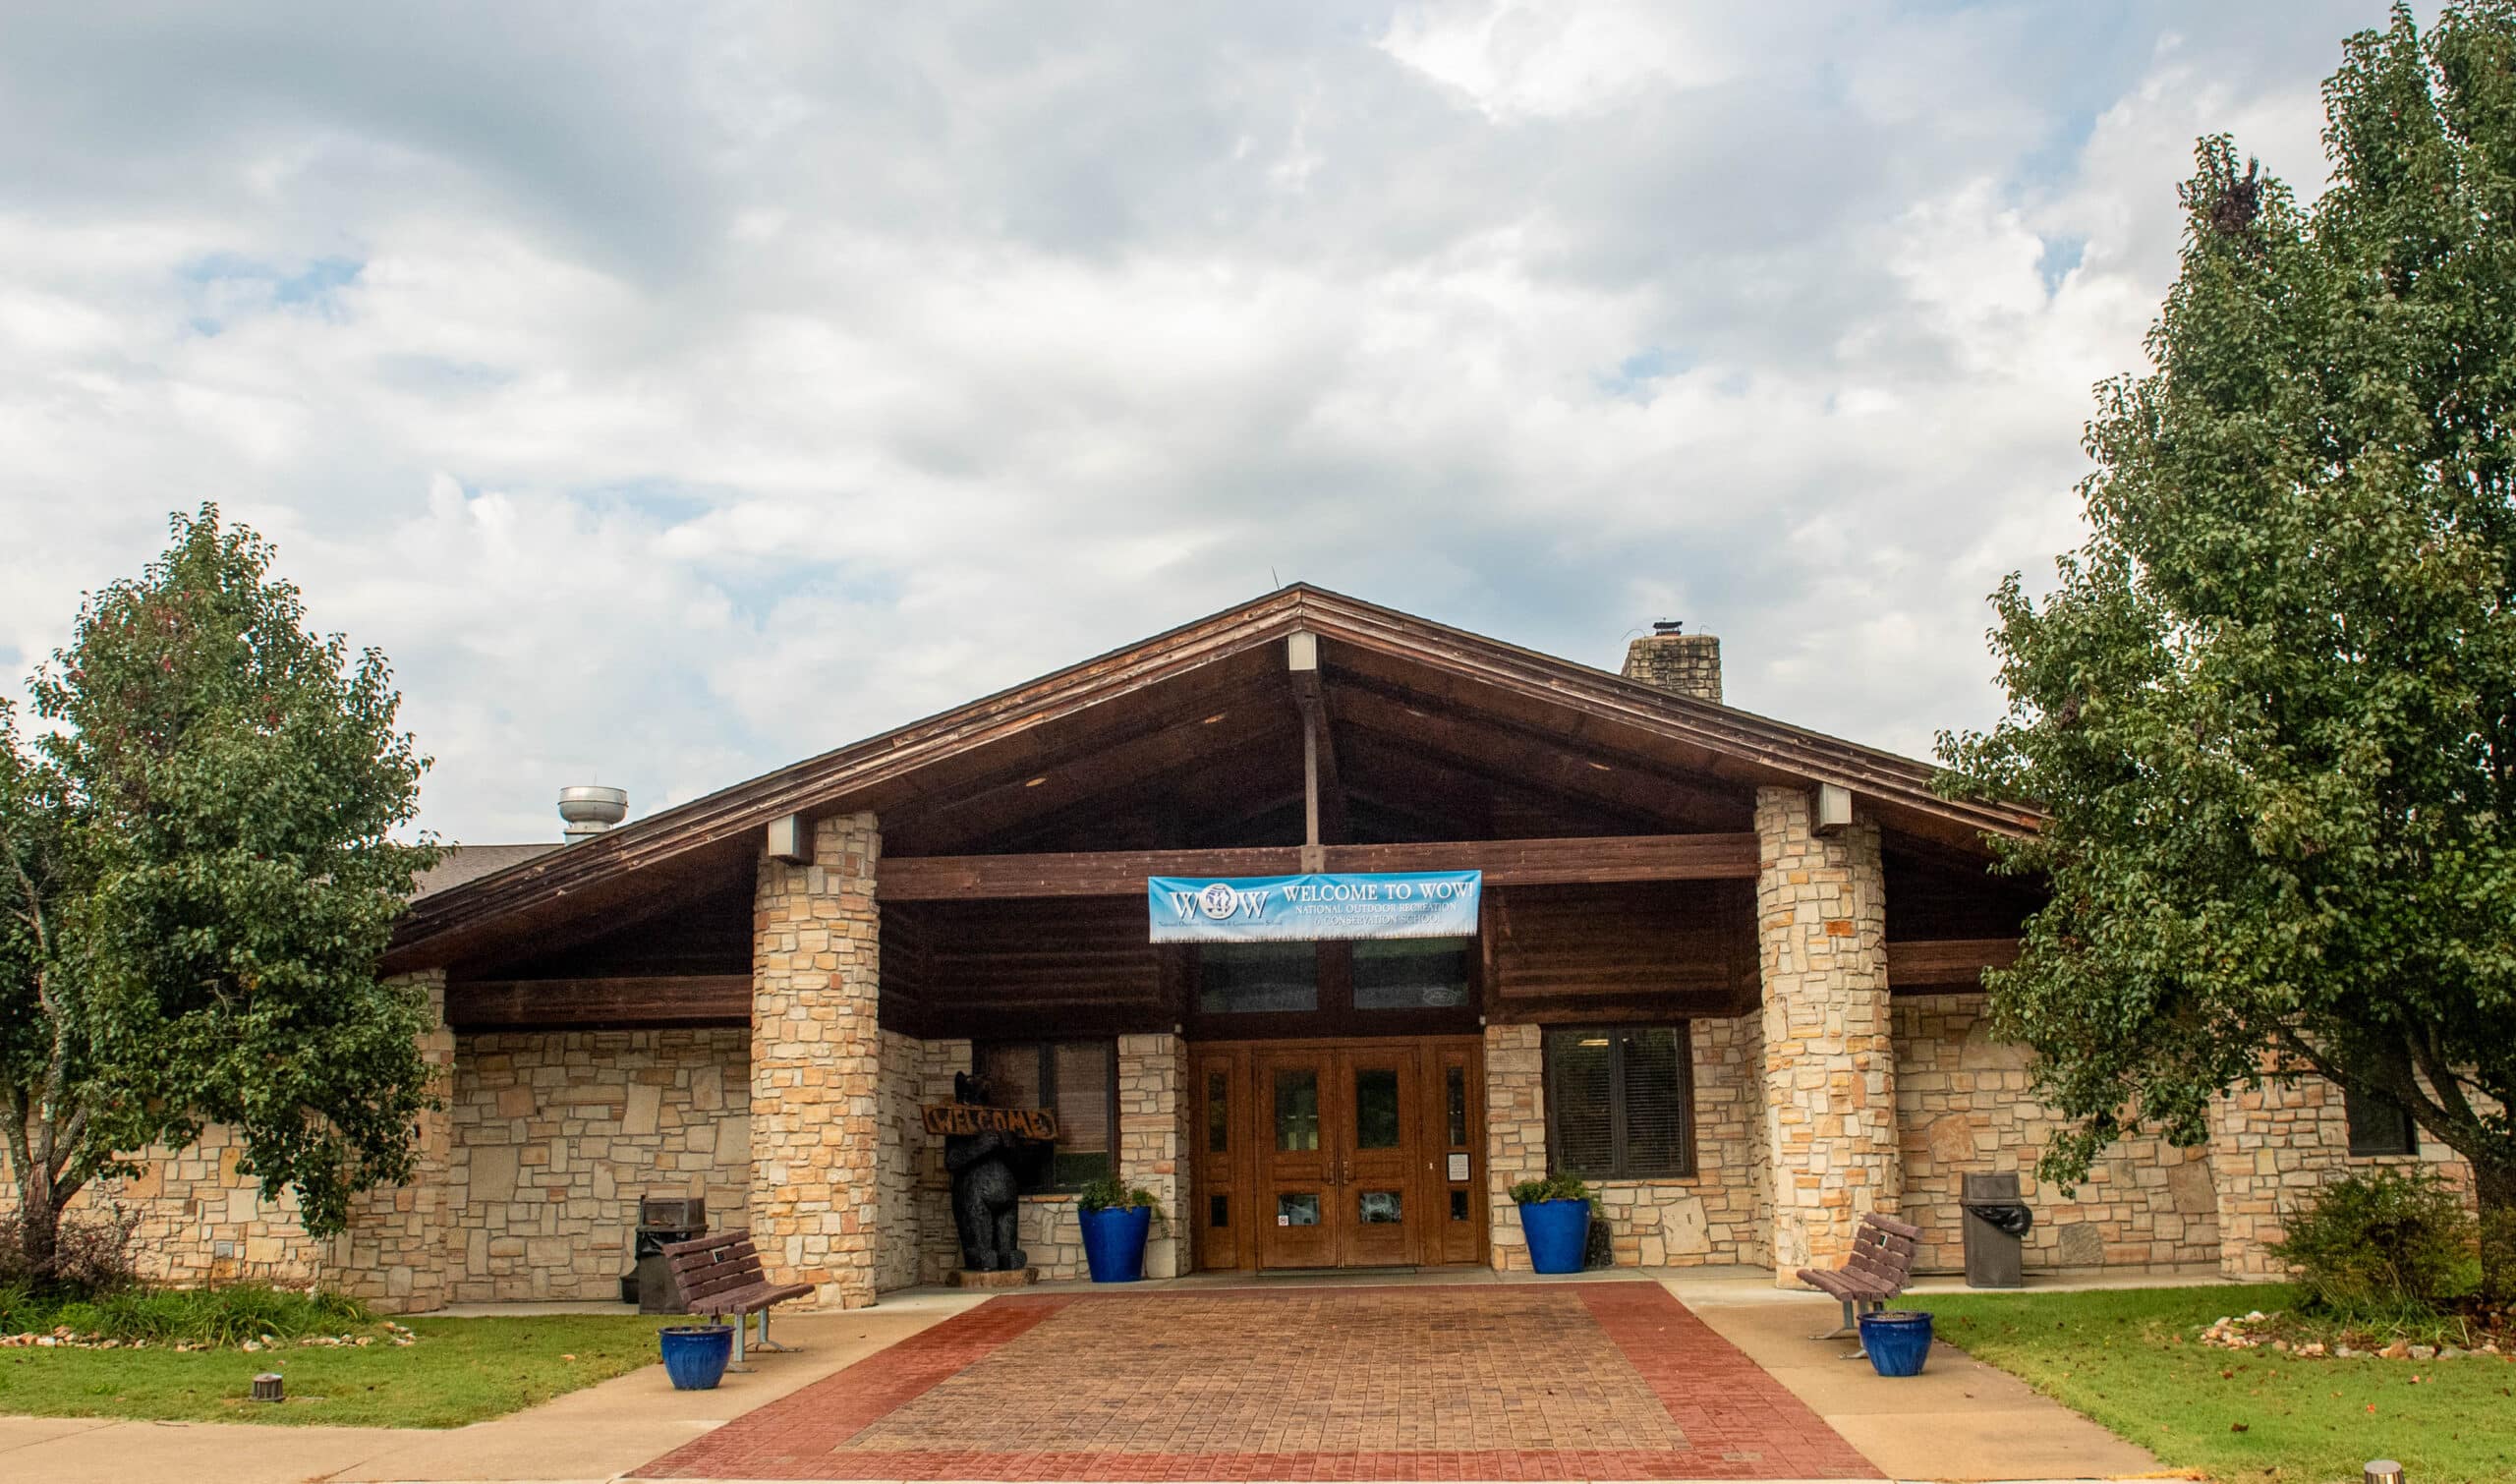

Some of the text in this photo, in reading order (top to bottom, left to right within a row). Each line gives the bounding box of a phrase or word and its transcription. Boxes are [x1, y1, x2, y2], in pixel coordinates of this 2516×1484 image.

[1282, 882, 1473, 903] WELCOME TO WOW!
[1295, 902, 1458, 915] NATIONAL OUTDOOR RECREATION
[1324, 914, 1398, 927] CONSERVATION
[1400, 913, 1440, 924] SCHOOL
[932, 1108, 1048, 1138] WELCOME
